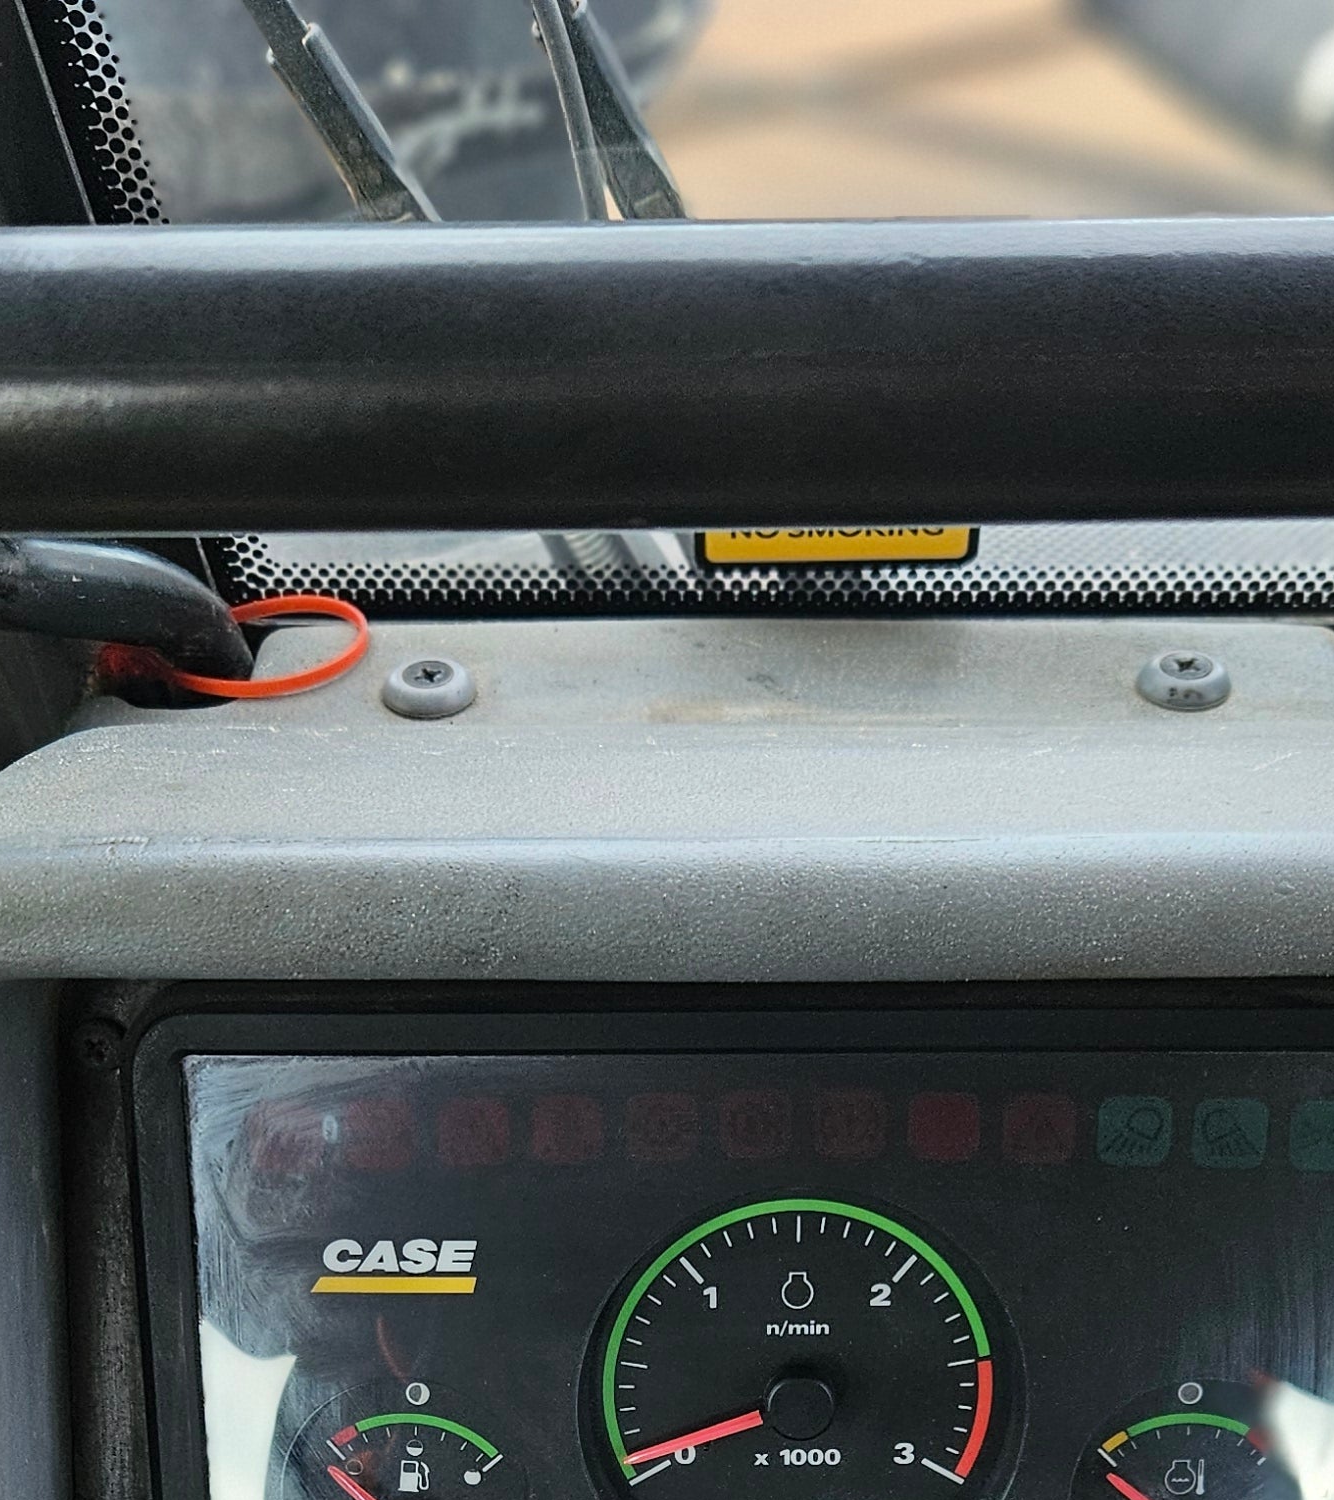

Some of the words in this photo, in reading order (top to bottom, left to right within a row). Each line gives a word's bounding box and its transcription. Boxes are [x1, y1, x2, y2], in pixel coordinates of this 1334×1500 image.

[322, 1238, 478, 1275] CASE
[702, 1286, 718, 1310] 1
[869, 1282, 893, 1307] 2
[766, 1319, 831, 1337] n/min
[674, 1444, 697, 1465] 0
[753, 1452, 770, 1467] x
[778, 1448, 842, 1467] 1000
[892, 1441, 916, 1465] 3
